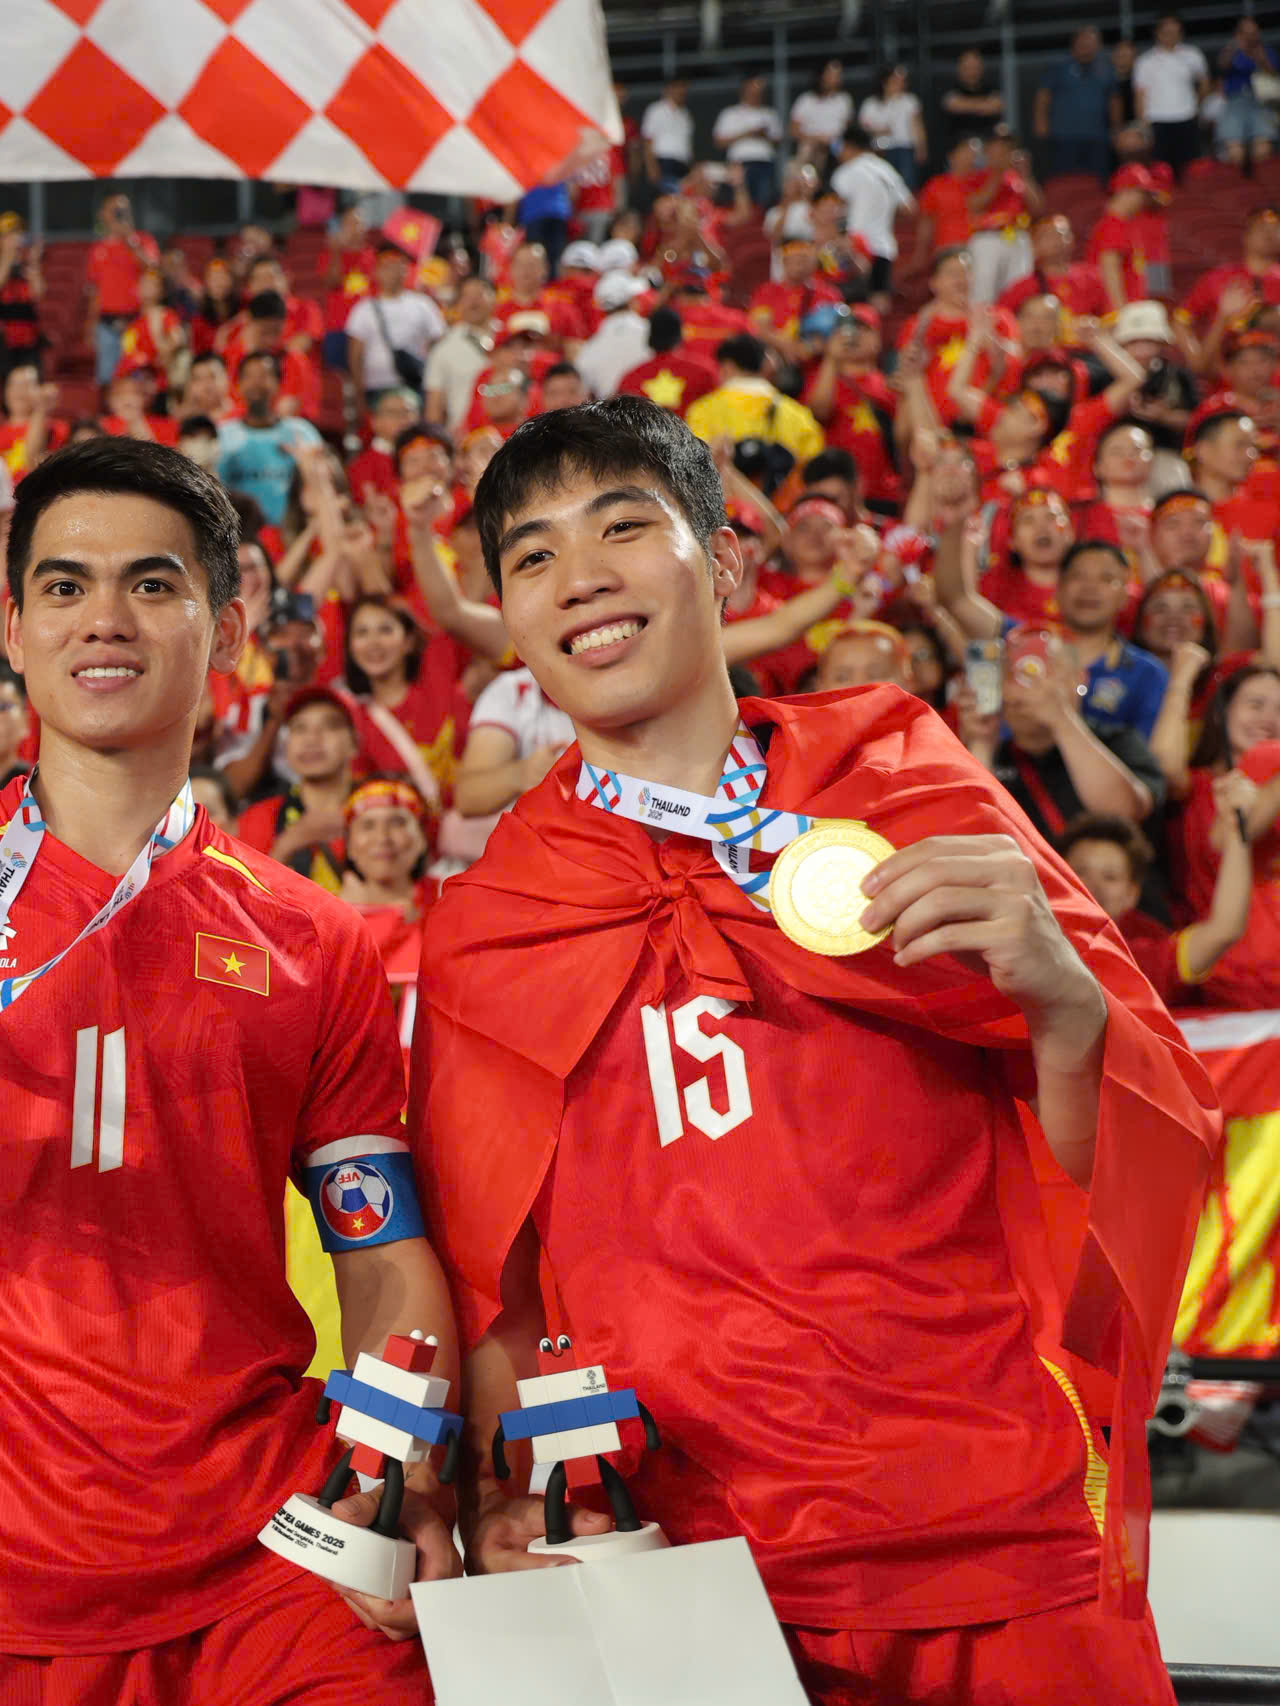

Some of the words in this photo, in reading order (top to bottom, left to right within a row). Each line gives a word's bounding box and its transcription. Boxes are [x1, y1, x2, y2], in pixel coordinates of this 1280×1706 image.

[647, 809, 663, 821] 2025
[651, 797, 691, 817] THAILAND
[640, 995, 753, 1148] 15
[70, 1024, 127, 1173] 11
[338, 1171, 361, 1185] VFF
[284, 1513, 296, 1525] SEA
[294, 1520, 322, 1539] GAMES
[321, 1533, 346, 1549] 2025
